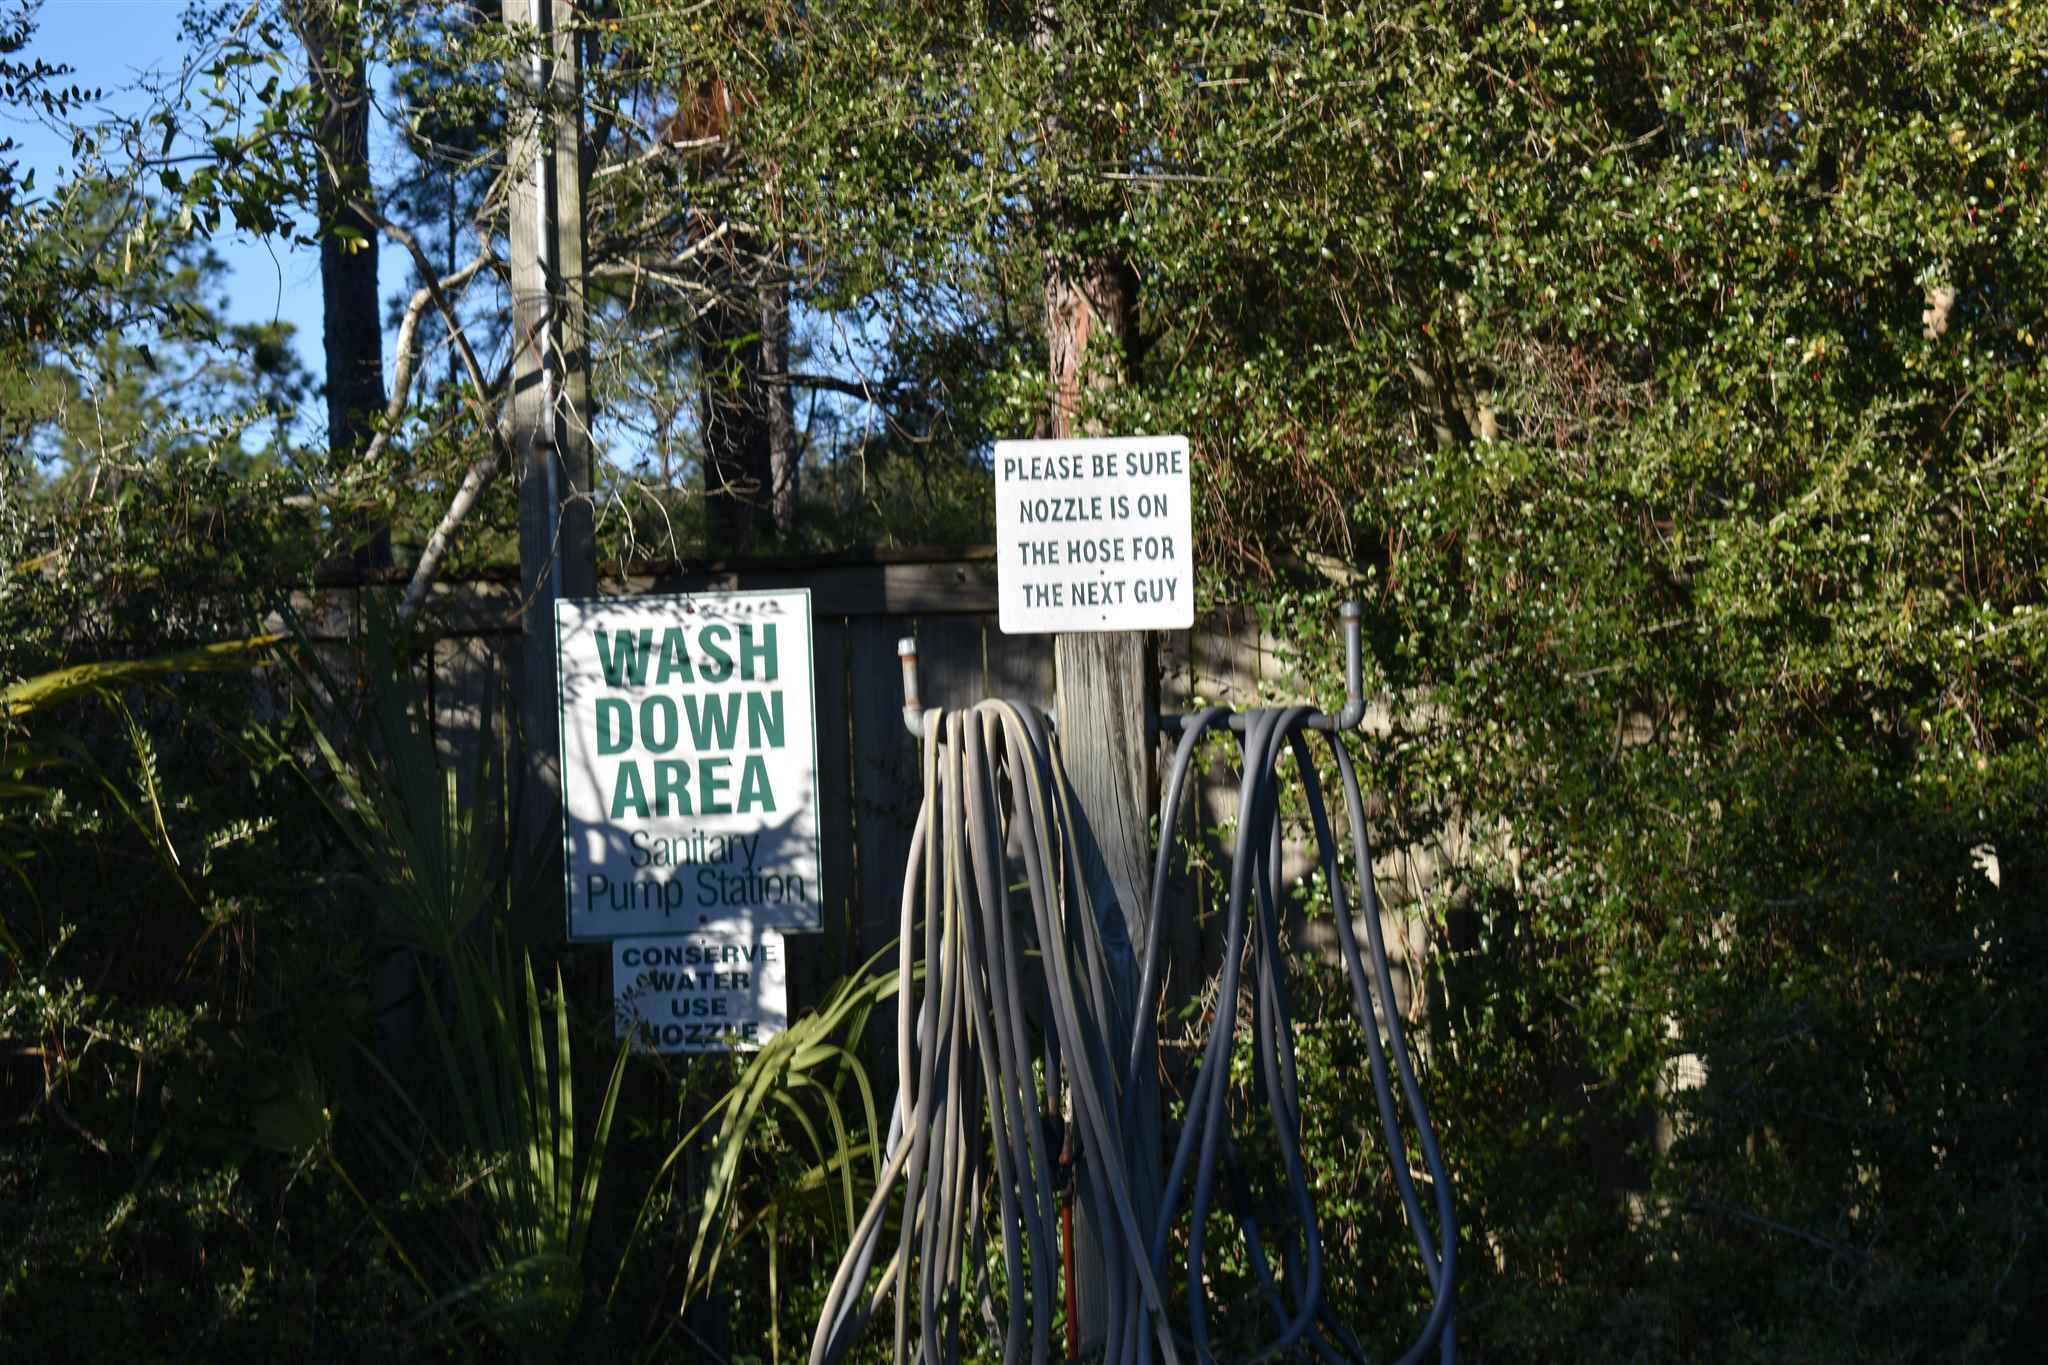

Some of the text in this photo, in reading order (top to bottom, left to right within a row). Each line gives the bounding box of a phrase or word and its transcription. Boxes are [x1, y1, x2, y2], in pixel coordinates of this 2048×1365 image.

[1005, 450, 1182, 481] PLEASE BE SURE
[1020, 493, 1168, 523] NOZZLE IS ON
[1018, 535, 1174, 565] THE HOSE FOR
[1022, 577, 1177, 608] THE NEXT GUY
[593, 623, 779, 687] WASH
[595, 690, 785, 756] DOWN
[610, 754, 776, 819] AREA
[629, 828, 760, 871] Sanitary
[586, 866, 805, 917] Pump Station
[622, 944, 777, 967] CONSERVE
[652, 972, 751, 992] WATER
[671, 997, 727, 1017] USE
